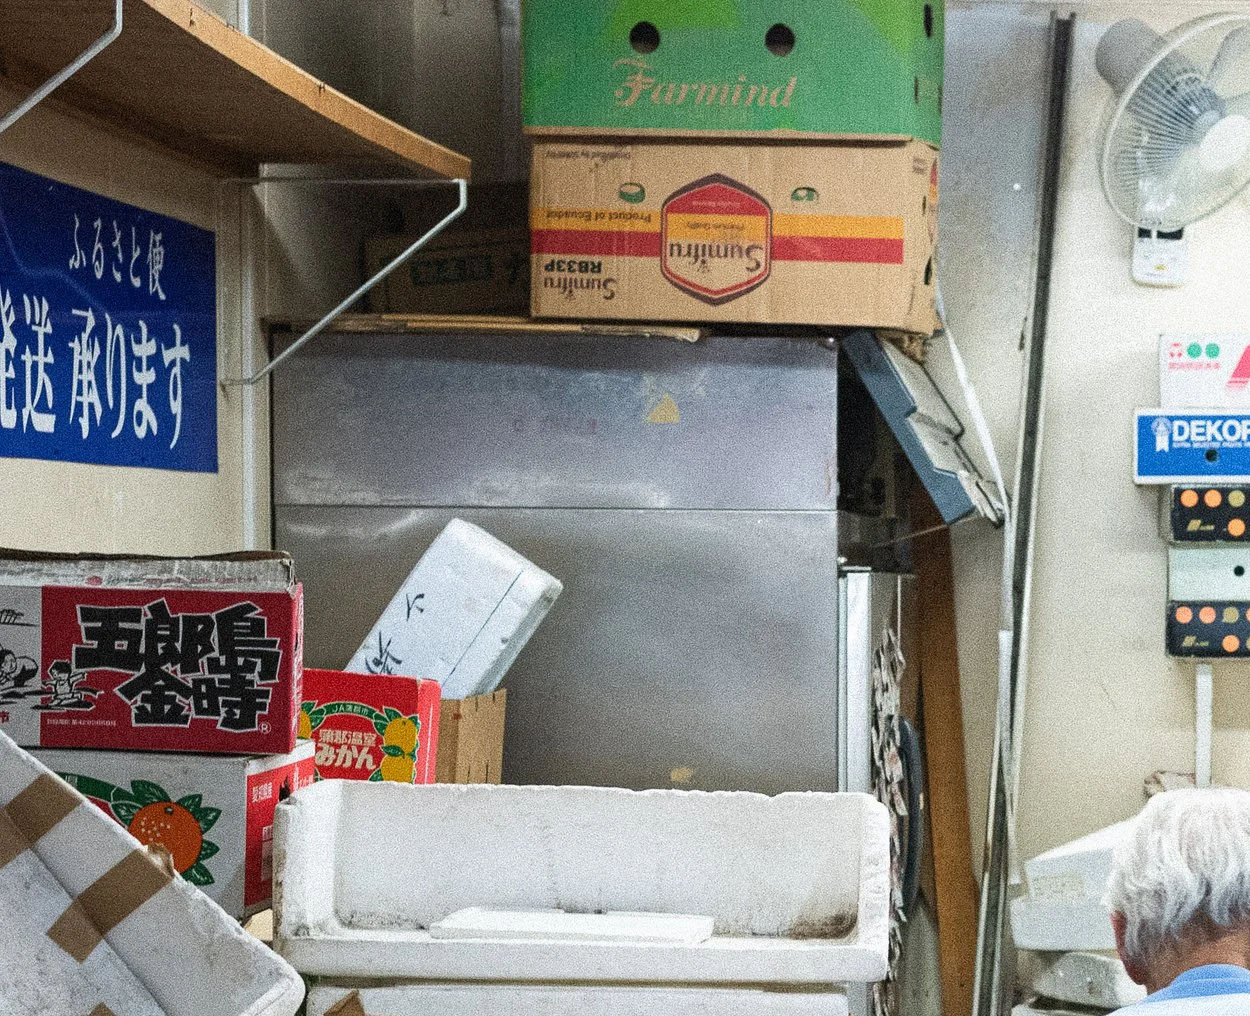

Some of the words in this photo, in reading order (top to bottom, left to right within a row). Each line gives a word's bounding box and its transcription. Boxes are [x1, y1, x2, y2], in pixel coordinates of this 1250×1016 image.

[613, 58, 797, 108] Farmind
[595, 211, 605, 222] of
[608, 212, 652, 223] Product
[69, 213, 166, 300] ふるさと便
[543, 259, 602, 273] RB33P
[668, 240, 763, 274] Sumifru
[543, 275, 617, 301] Sumifru
[69, 308, 190, 449] 承ります
[114, 670, 272, 732] 金時
[314, 744, 376, 770] みかん
